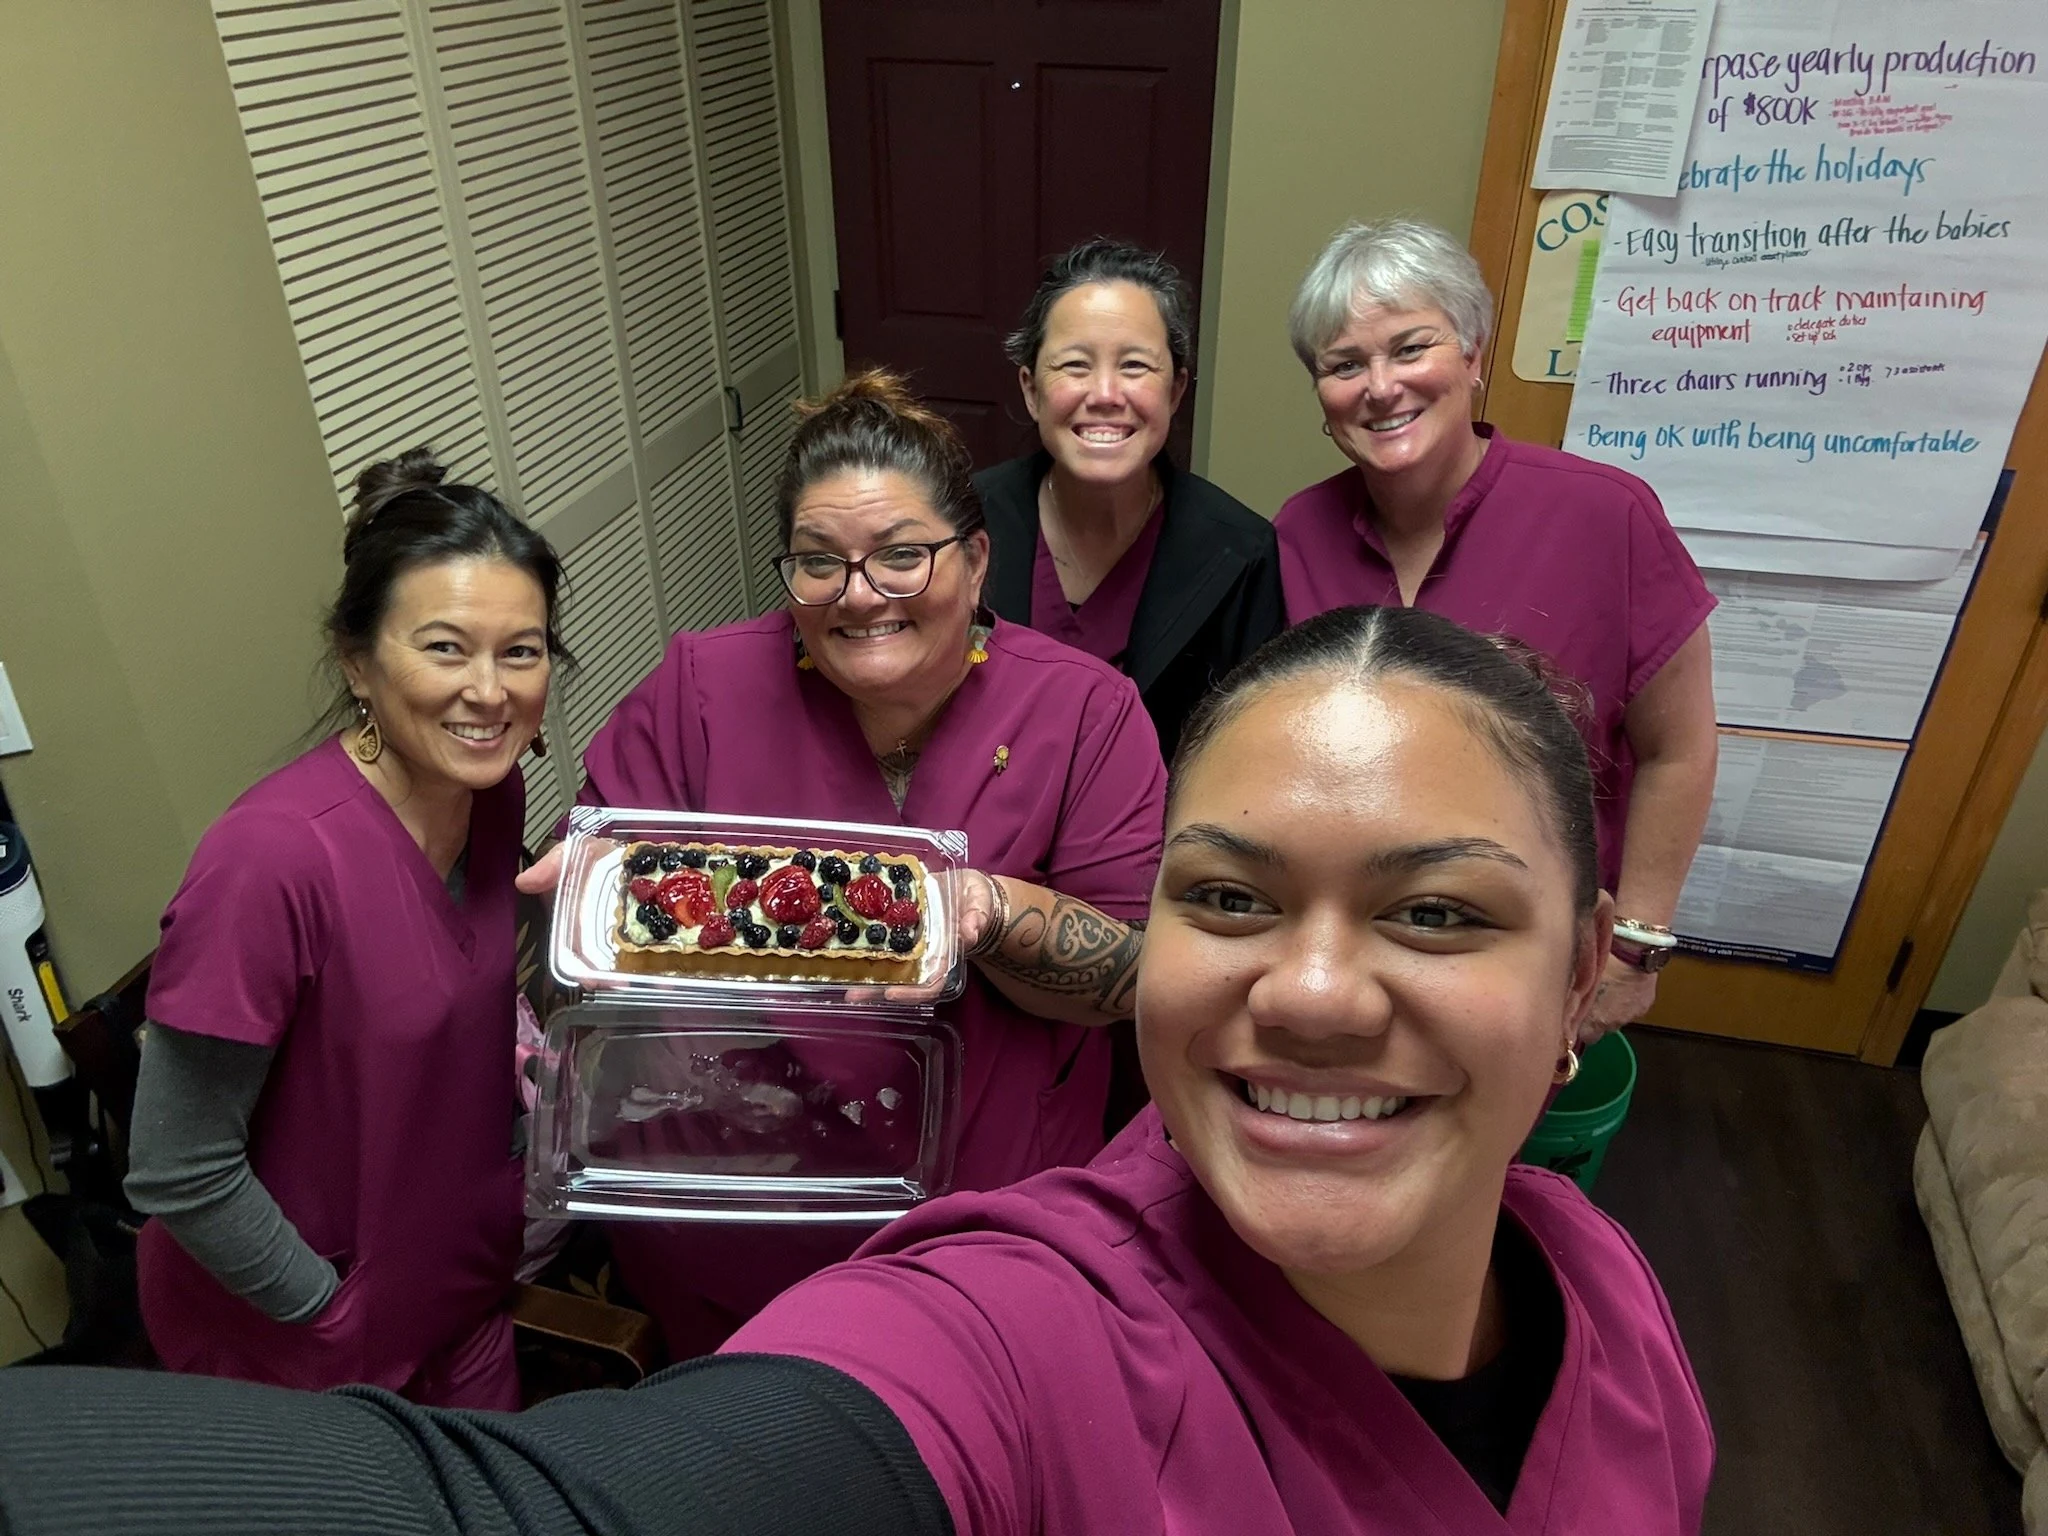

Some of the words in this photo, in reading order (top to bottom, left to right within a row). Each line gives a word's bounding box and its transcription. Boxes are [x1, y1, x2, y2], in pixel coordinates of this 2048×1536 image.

[1784, 42, 1876, 96] yearly
[1881, 38, 2037, 94] production
[1707, 95, 1735, 132] of
[1764, 147, 1808, 185] the
[1815, 143, 1937, 197] holidays
[1627, 227, 1679, 265] Easy
[1685, 219, 1807, 258] transition
[1818, 217, 1879, 247] after
[1883, 213, 1930, 244] the
[1936, 208, 2012, 240] babies
[1617, 285, 1659, 317] Get
[1667, 286, 1723, 313] back
[1728, 294, 1757, 313] on
[1761, 284, 1826, 313] track
[1836, 283, 1988, 317] maintaining
[1651, 318, 1751, 349] equipment
[1607, 371, 1668, 396] Three
[1676, 369, 1738, 393] chairs
[1745, 368, 1828, 396] running
[1588, 423, 1647, 461] Being
[1655, 424, 1686, 449] OK
[1692, 419, 1742, 449] with
[1747, 421, 1816, 463] being
[1823, 429, 1981, 460] uncomfortable
[7, 987, 33, 1023] Shark
